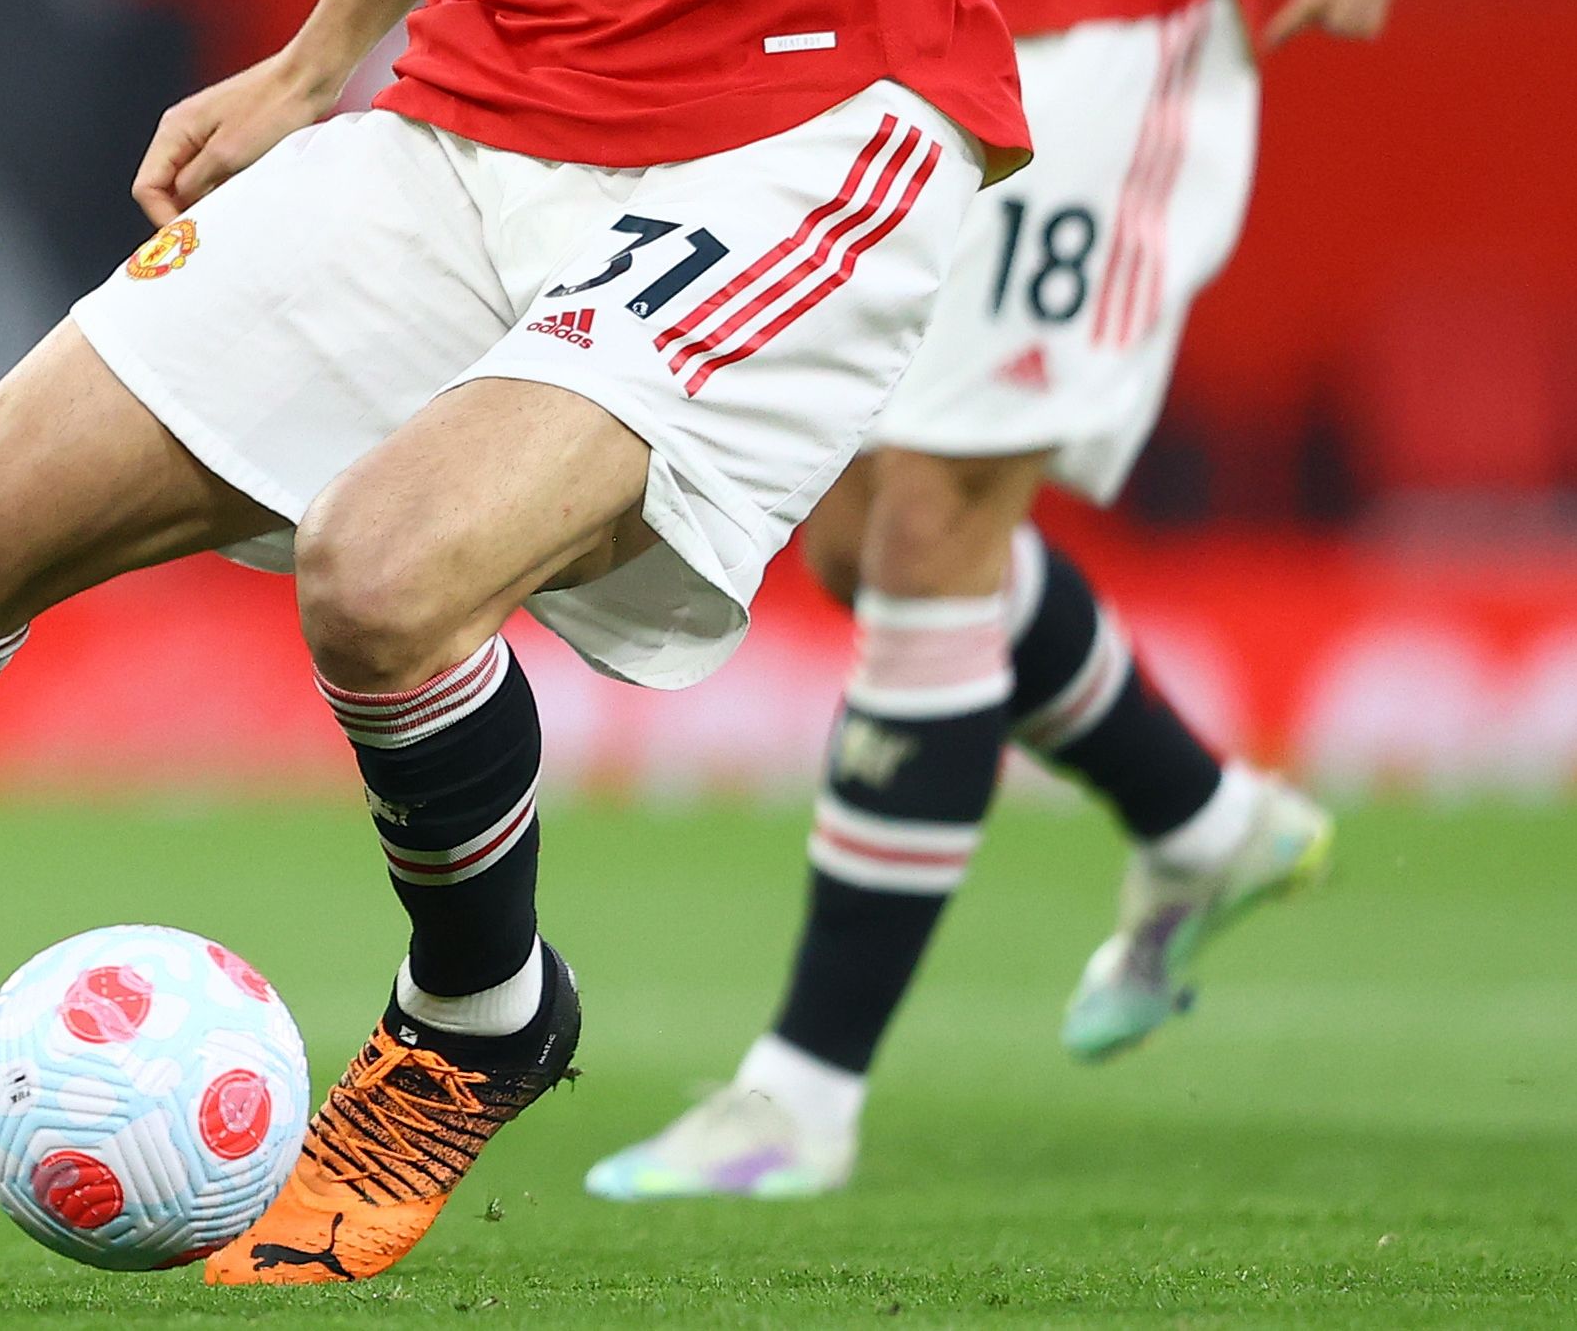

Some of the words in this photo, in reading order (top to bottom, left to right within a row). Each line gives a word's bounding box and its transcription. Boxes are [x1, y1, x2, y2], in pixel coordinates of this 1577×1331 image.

[544, 213, 731, 320] 31
[991, 198, 1096, 323] 18
[526, 322, 594, 350] adidas
